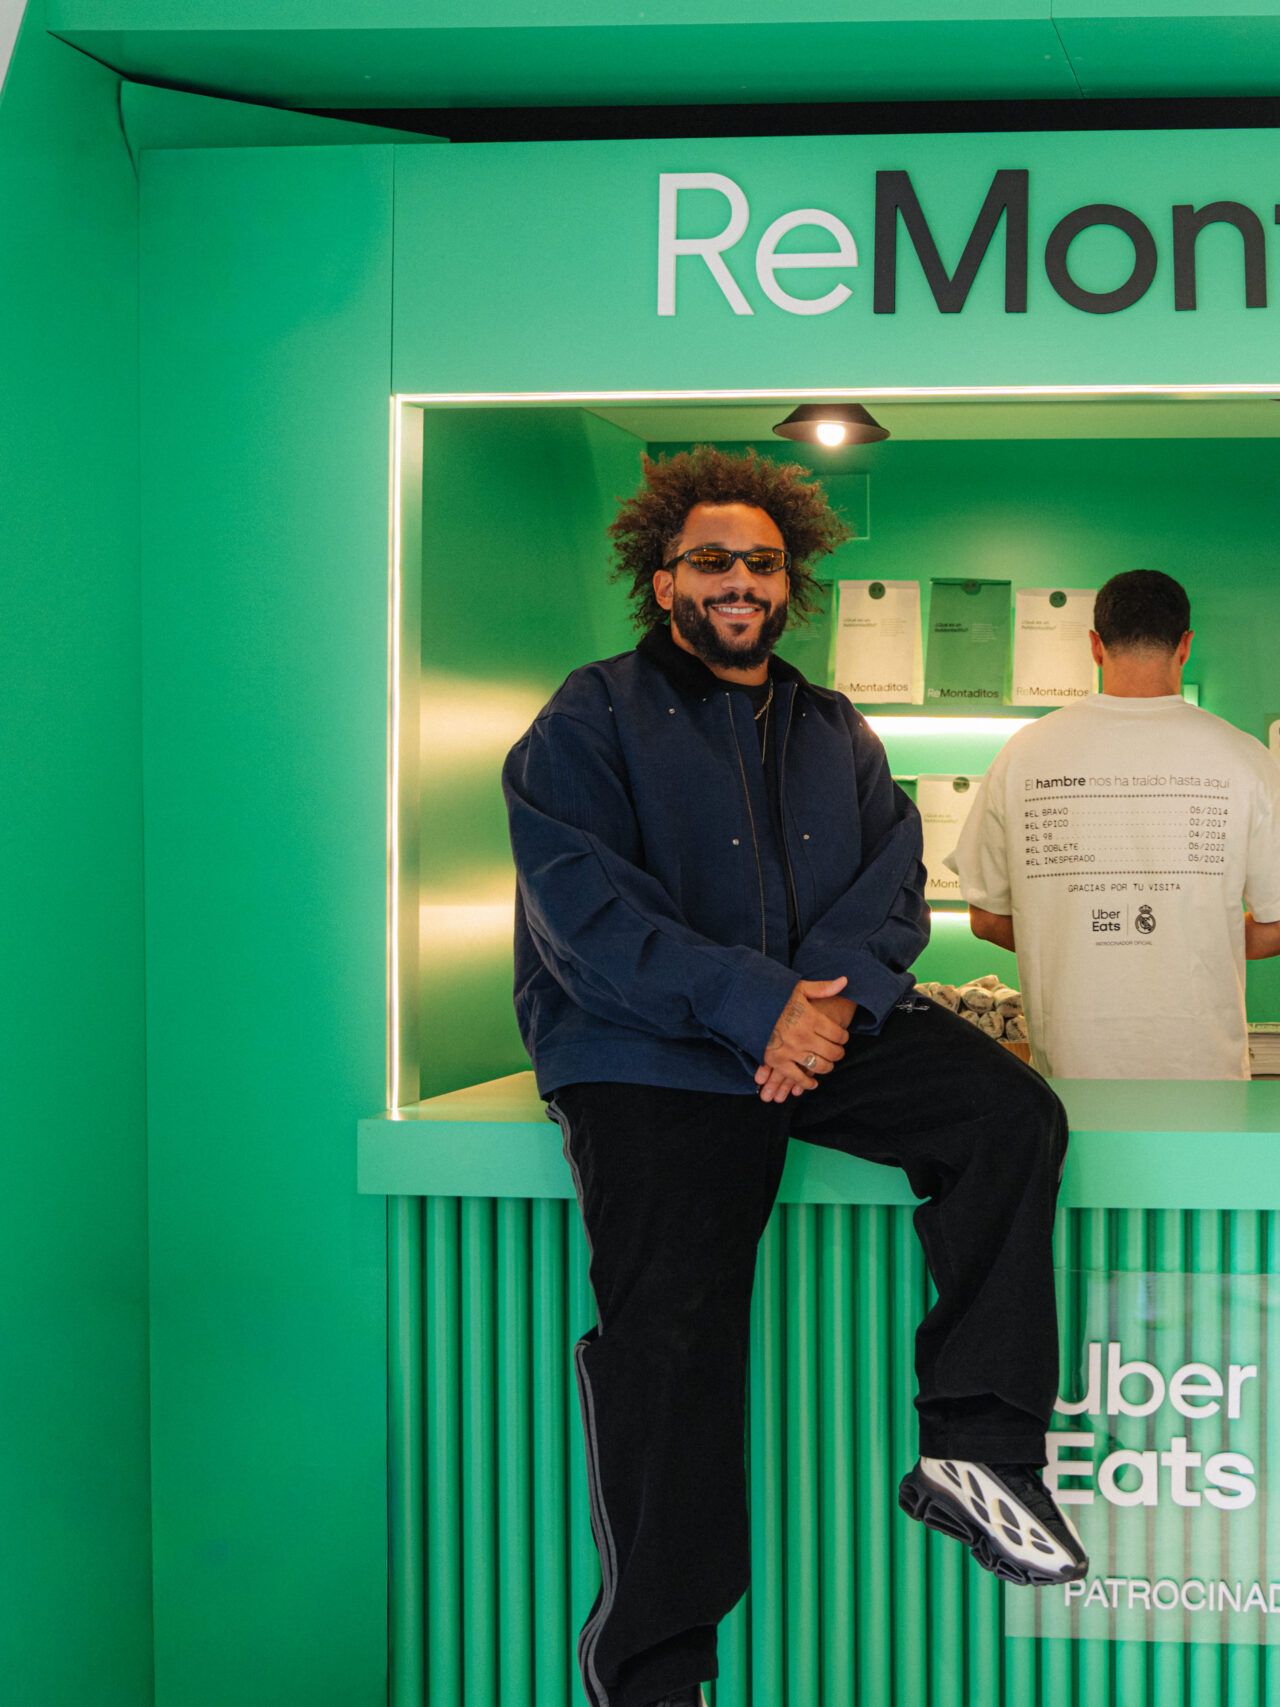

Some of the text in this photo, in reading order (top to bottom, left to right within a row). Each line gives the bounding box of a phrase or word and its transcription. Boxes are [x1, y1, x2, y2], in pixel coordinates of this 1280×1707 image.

[1025, 774, 1230, 791] El hambre nos ha traído hasta aquí
[1042, 808, 1068, 816] BRAVO
[1189, 818, 1227, 827] 02/2017
[1042, 832, 1053, 840] 98
[1189, 830, 1226, 840] 04/2018
[1043, 843, 1079, 852] DOBLETE
[1044, 854, 1095, 864] INESPERADO
[1068, 883, 1180, 892] GRACIAS POR TU VISITA
[1092, 909, 1120, 920] Uber
[1092, 921, 1120, 932] Eats
[1042, 1431, 1256, 1510] Eats
